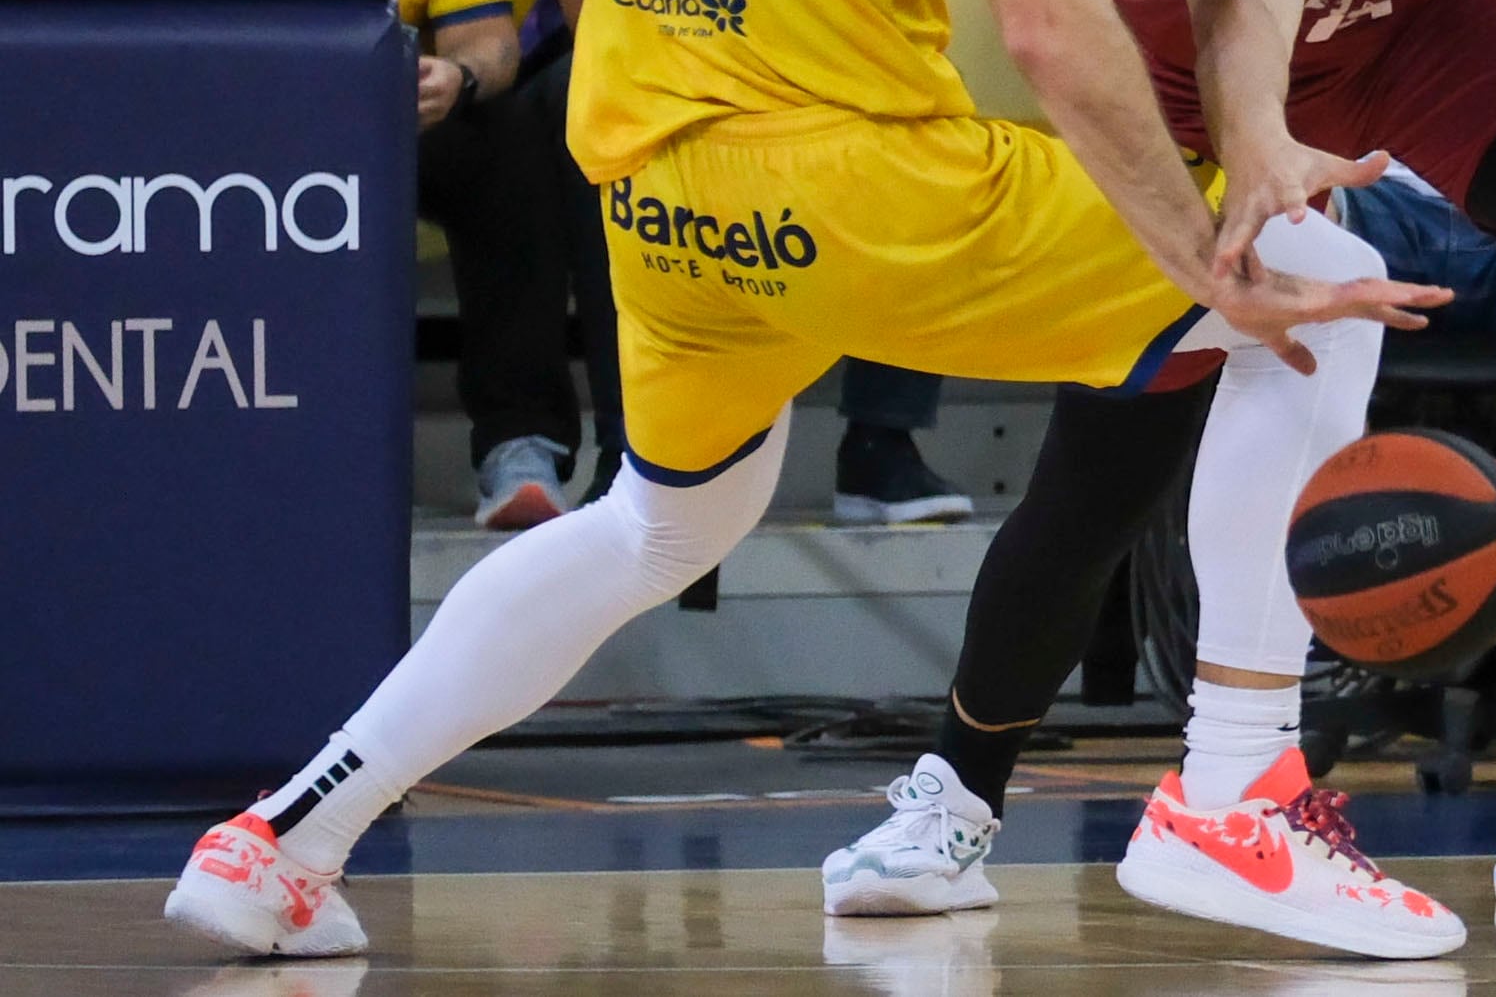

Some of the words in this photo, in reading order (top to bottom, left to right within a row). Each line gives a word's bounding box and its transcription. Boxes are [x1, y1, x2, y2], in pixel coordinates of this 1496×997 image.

[609, 174, 818, 271] Barceló
[641, 251, 703, 279] HOTE
[0, 317, 299, 412] ENTAL
